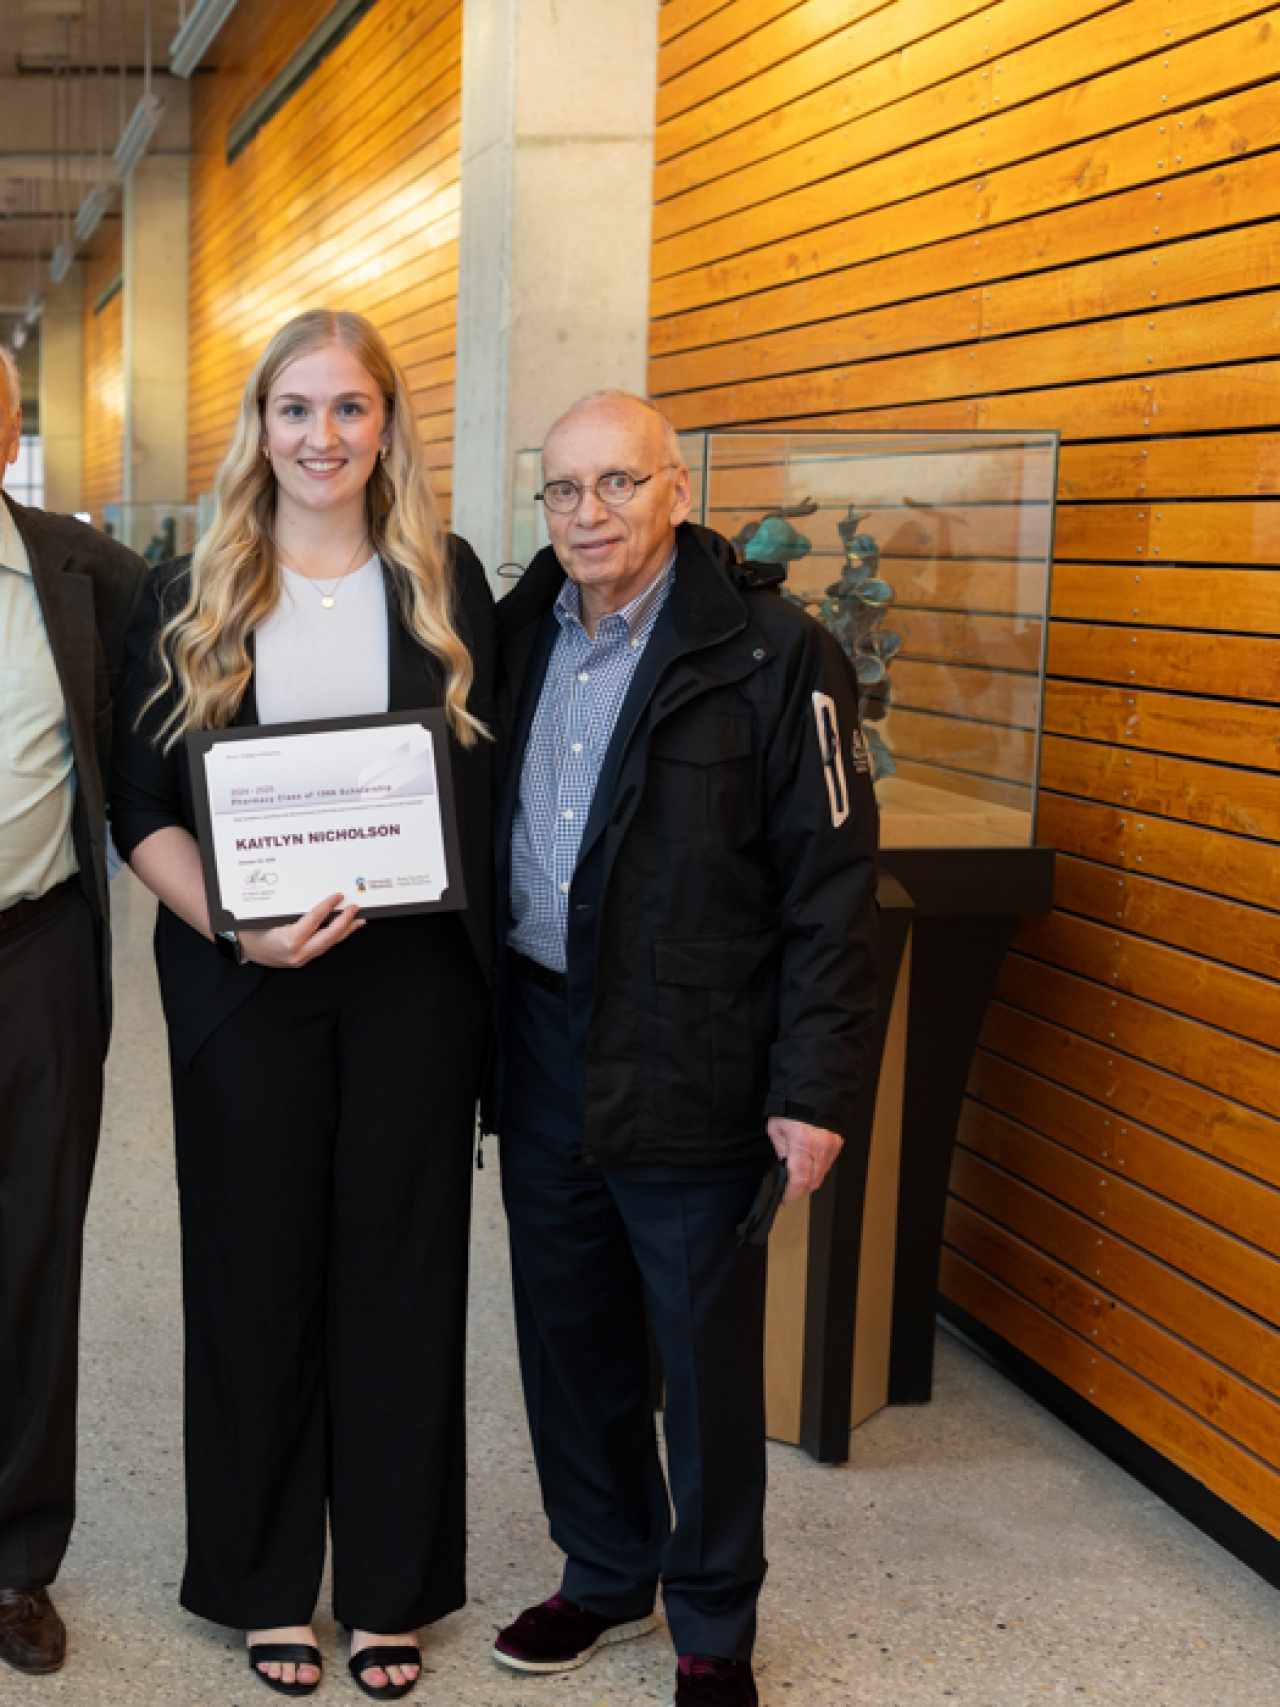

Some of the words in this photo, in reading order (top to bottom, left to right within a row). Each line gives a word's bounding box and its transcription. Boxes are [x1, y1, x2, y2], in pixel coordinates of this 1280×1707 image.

[231, 796, 274, 806] Pharmacy
[339, 785, 392, 796] Scholarship
[235, 833, 303, 851] KAITLYN
[308, 824, 401, 844] NICHOLSON
